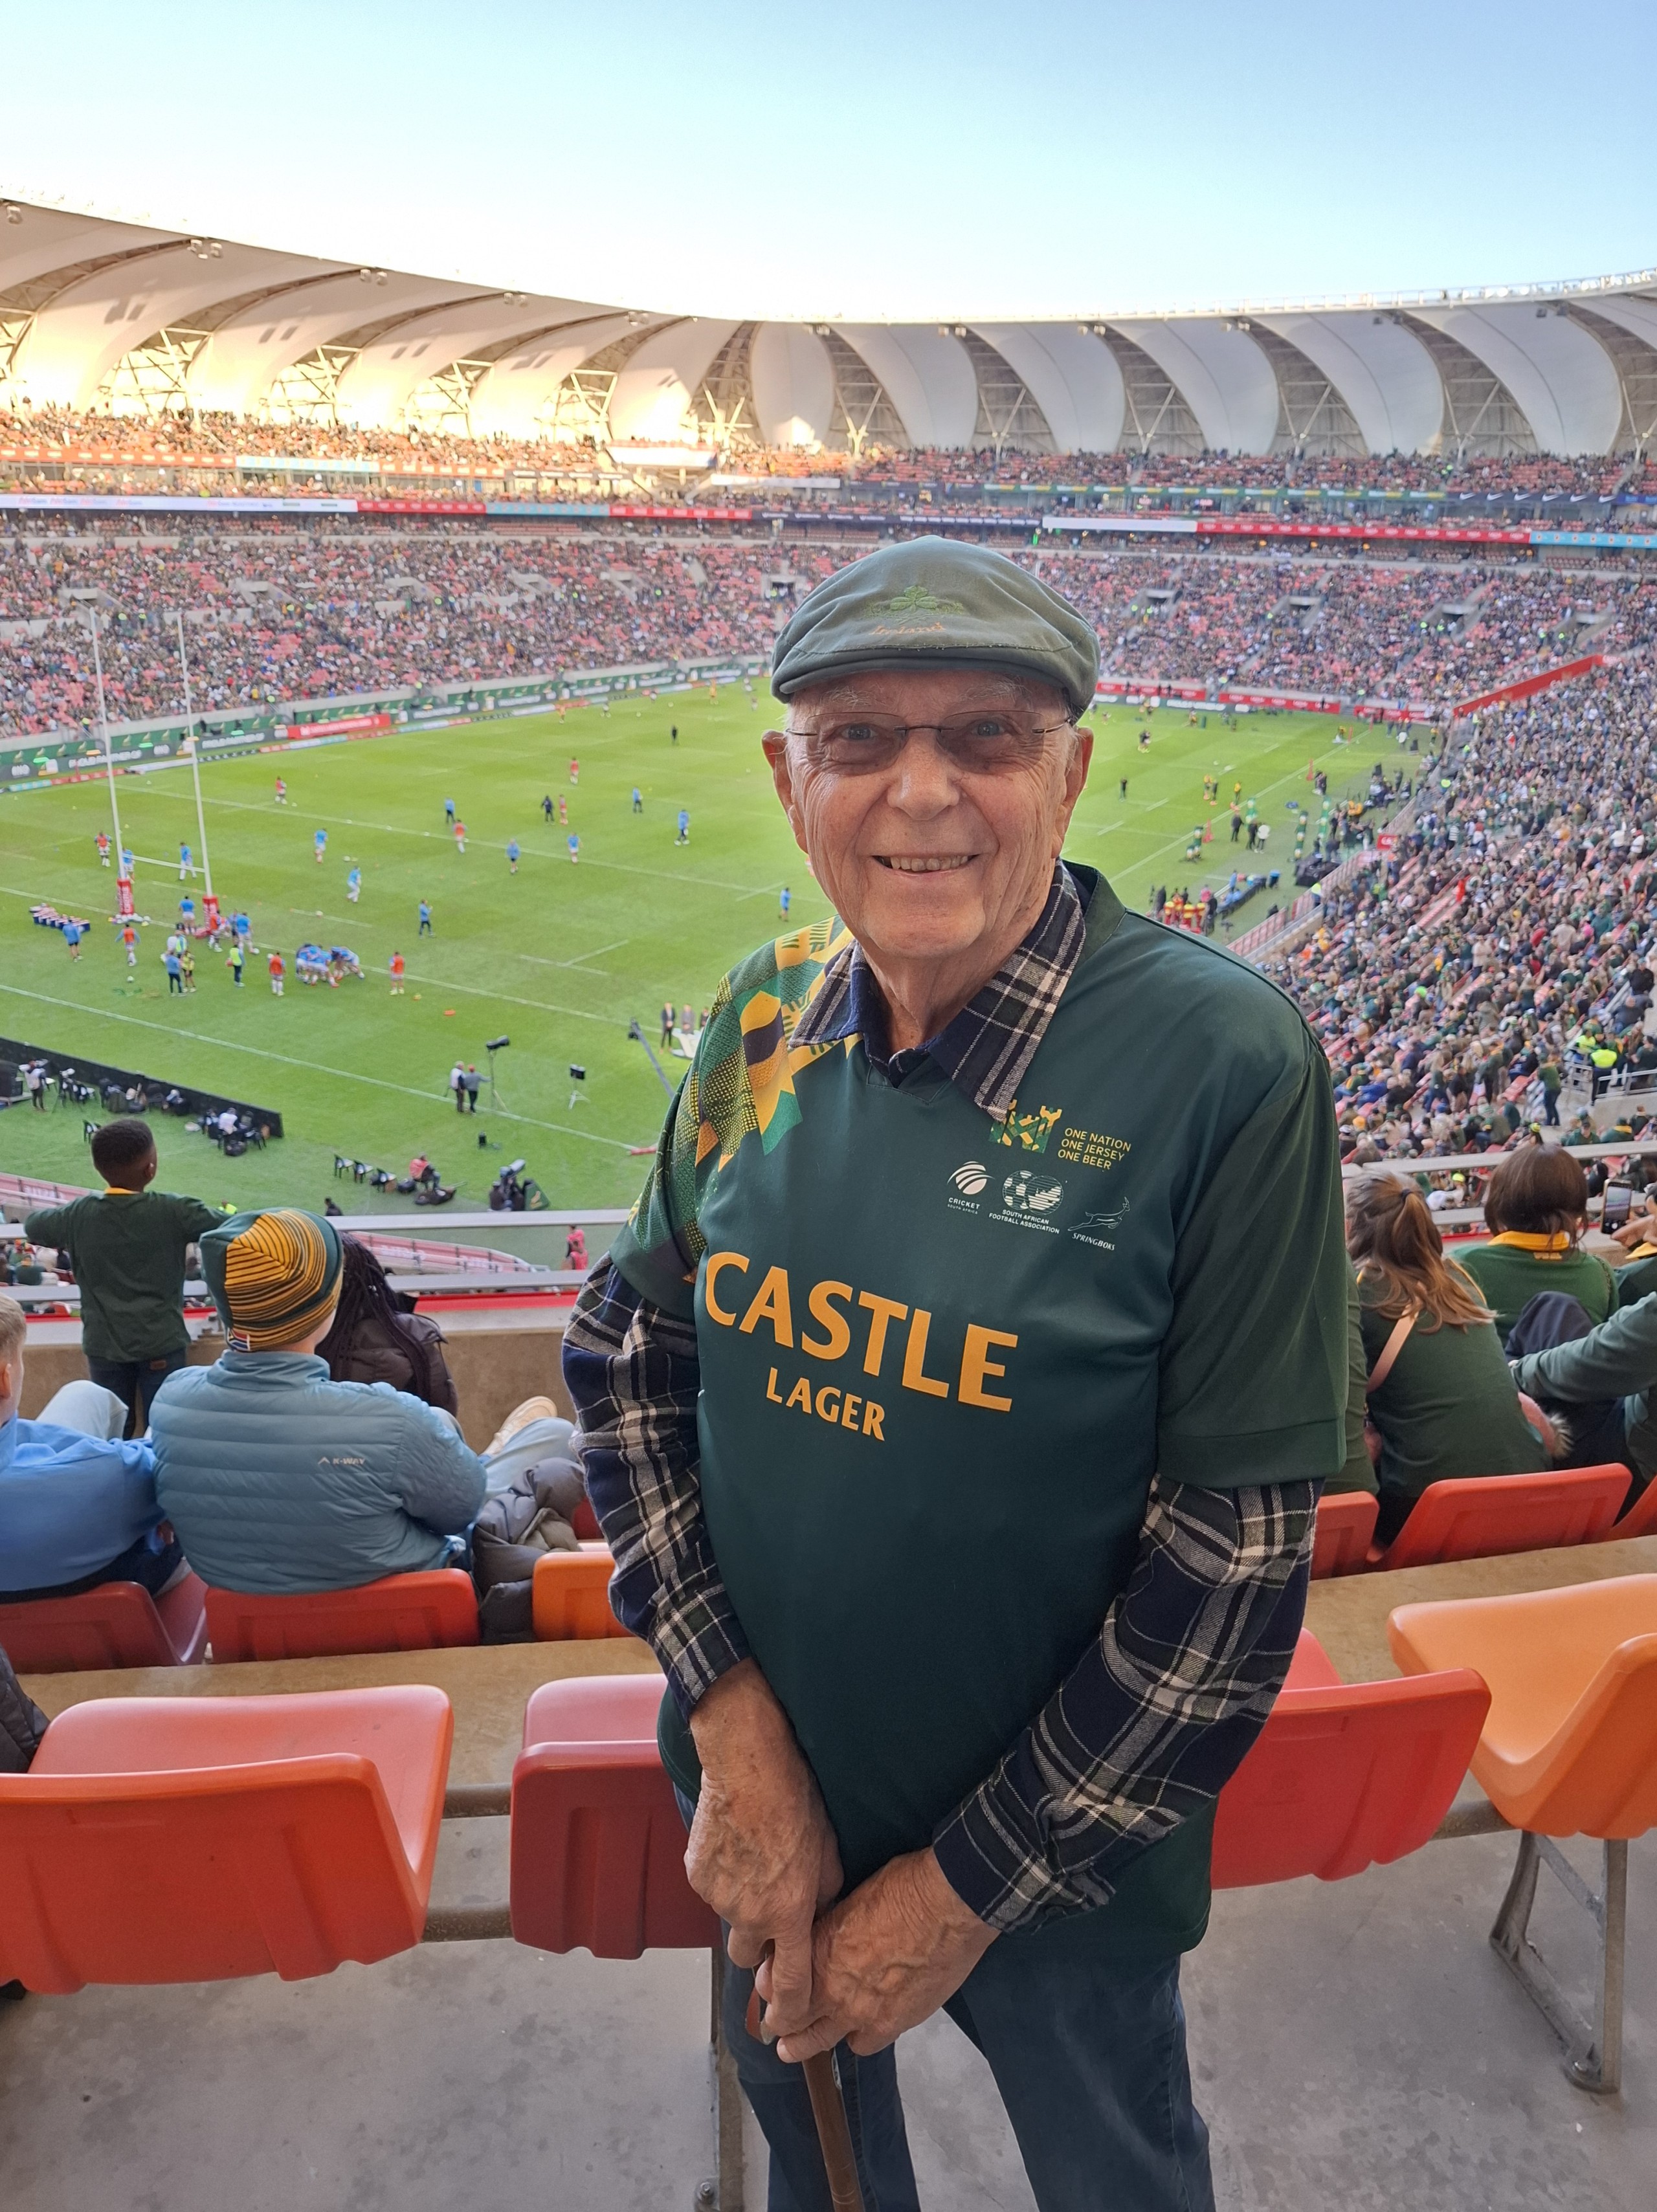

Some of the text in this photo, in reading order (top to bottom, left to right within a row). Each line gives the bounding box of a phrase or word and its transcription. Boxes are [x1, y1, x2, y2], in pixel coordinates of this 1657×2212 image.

[1062, 1138, 1125, 1162] ONE JERSEY
[1065, 1127, 1131, 1152] ONE NATION
[1058, 1149, 1112, 1170] ONE BEER
[948, 1197, 981, 1210] CRICKET
[988, 1213, 1060, 1235] FOOTBALL ASSOCIATION
[1002, 1209, 1049, 1225] SOUTH AFRICAN
[1072, 1232, 1116, 1251] SPRINGBOKS
[706, 1251, 1019, 1412] CASTLE
[766, 1366, 885, 1442] LAGER
